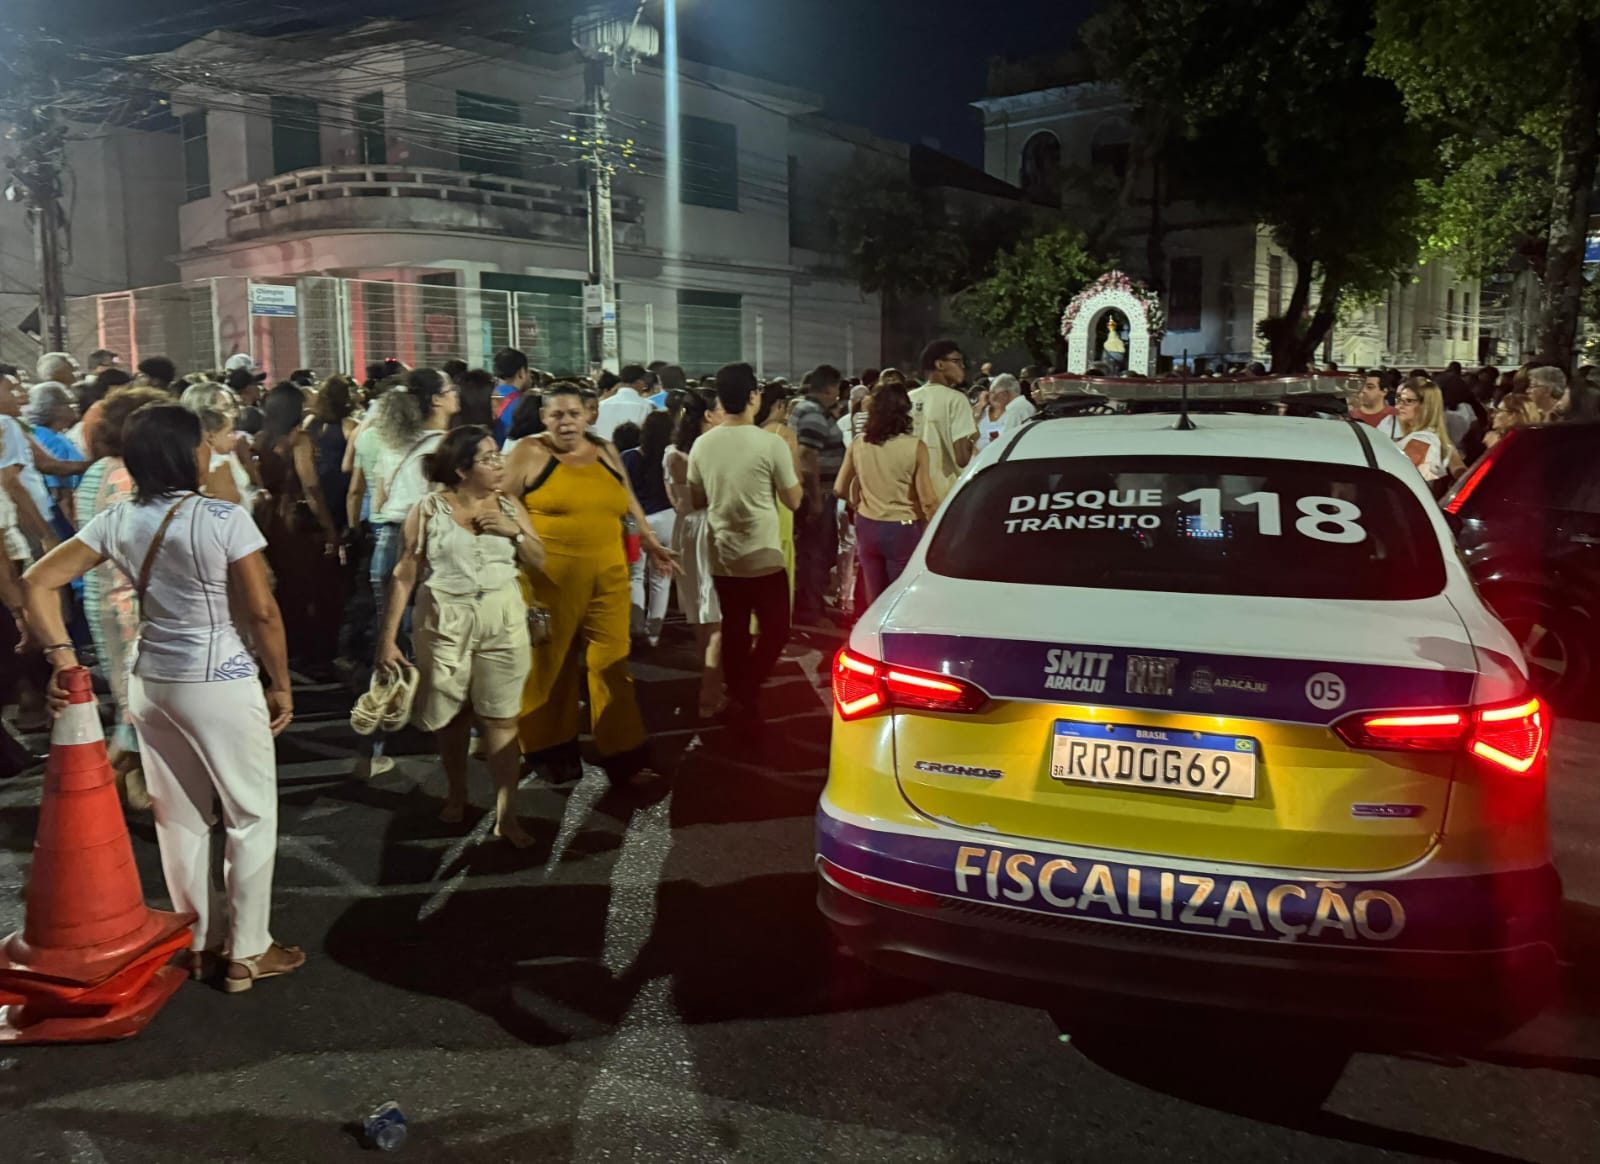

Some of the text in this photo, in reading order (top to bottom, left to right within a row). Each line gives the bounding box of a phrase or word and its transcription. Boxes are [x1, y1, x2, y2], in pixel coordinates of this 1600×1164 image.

[1009, 489, 1163, 514] DISQUE
[1004, 513, 1161, 534] TRÂNSITO
[1177, 487, 1367, 544] 118
[1044, 648, 1114, 678] SMTT
[1044, 674, 1106, 694] ARACAJU
[1214, 678, 1268, 693] ARACAJU
[1309, 679, 1342, 701] 05
[1135, 729, 1169, 741] BRASIL
[914, 760, 1005, 780] CRONOS
[954, 845, 1406, 942] FISCALIZAÇÃO
